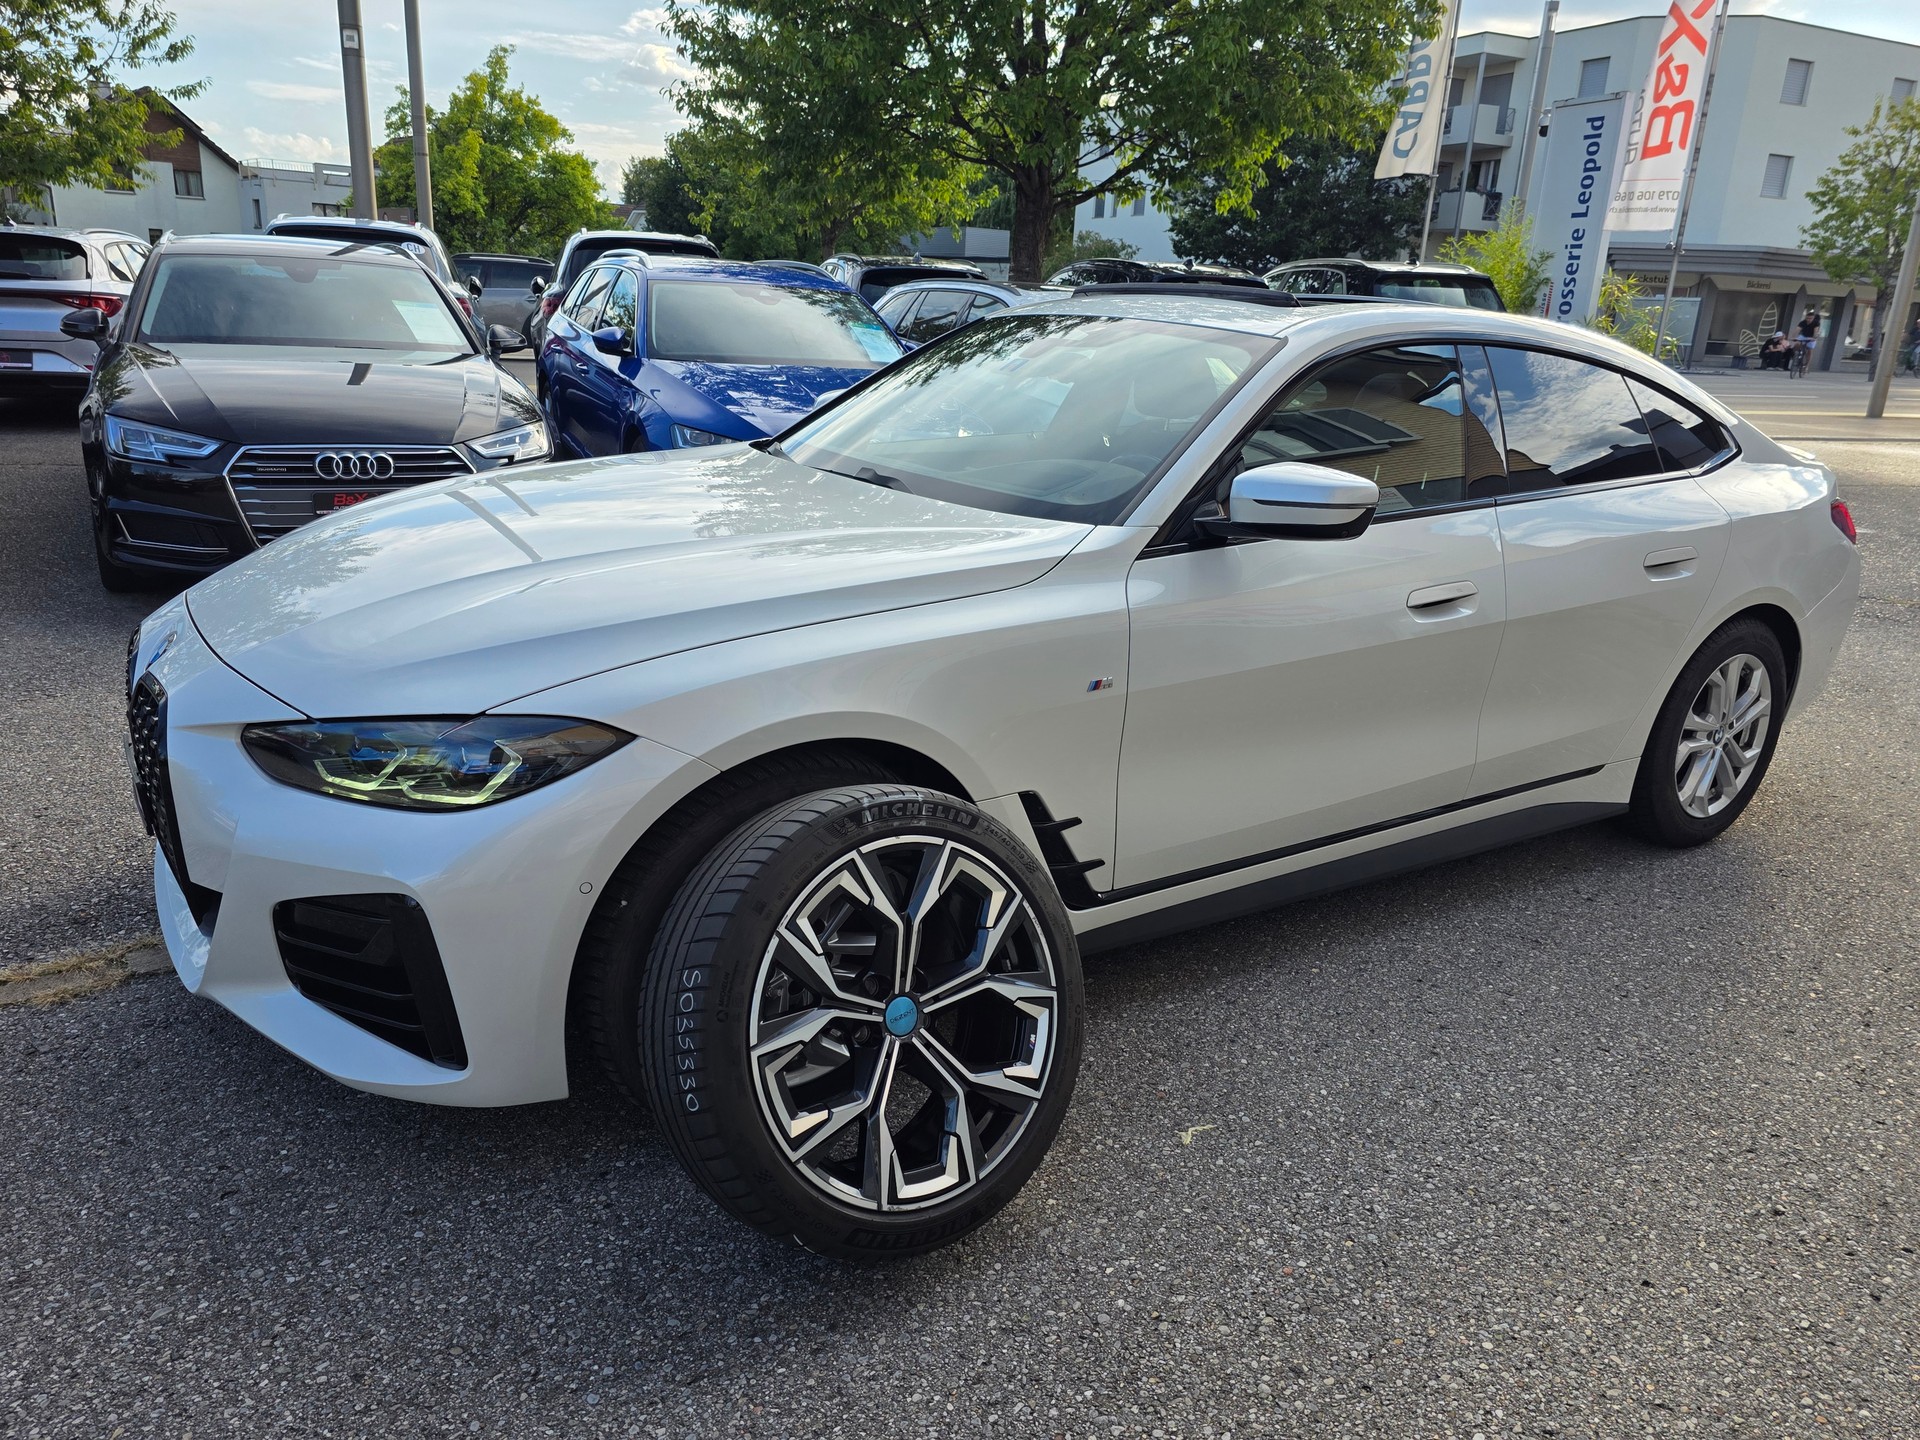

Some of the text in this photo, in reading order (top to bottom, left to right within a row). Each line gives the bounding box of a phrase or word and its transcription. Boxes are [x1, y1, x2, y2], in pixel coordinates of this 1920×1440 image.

[1571, 115, 1606, 219] Leopold
[406, 243, 421, 253] CH
[1540, 293, 1548, 317] uisse
[861, 802, 973, 826] MICHELIN
